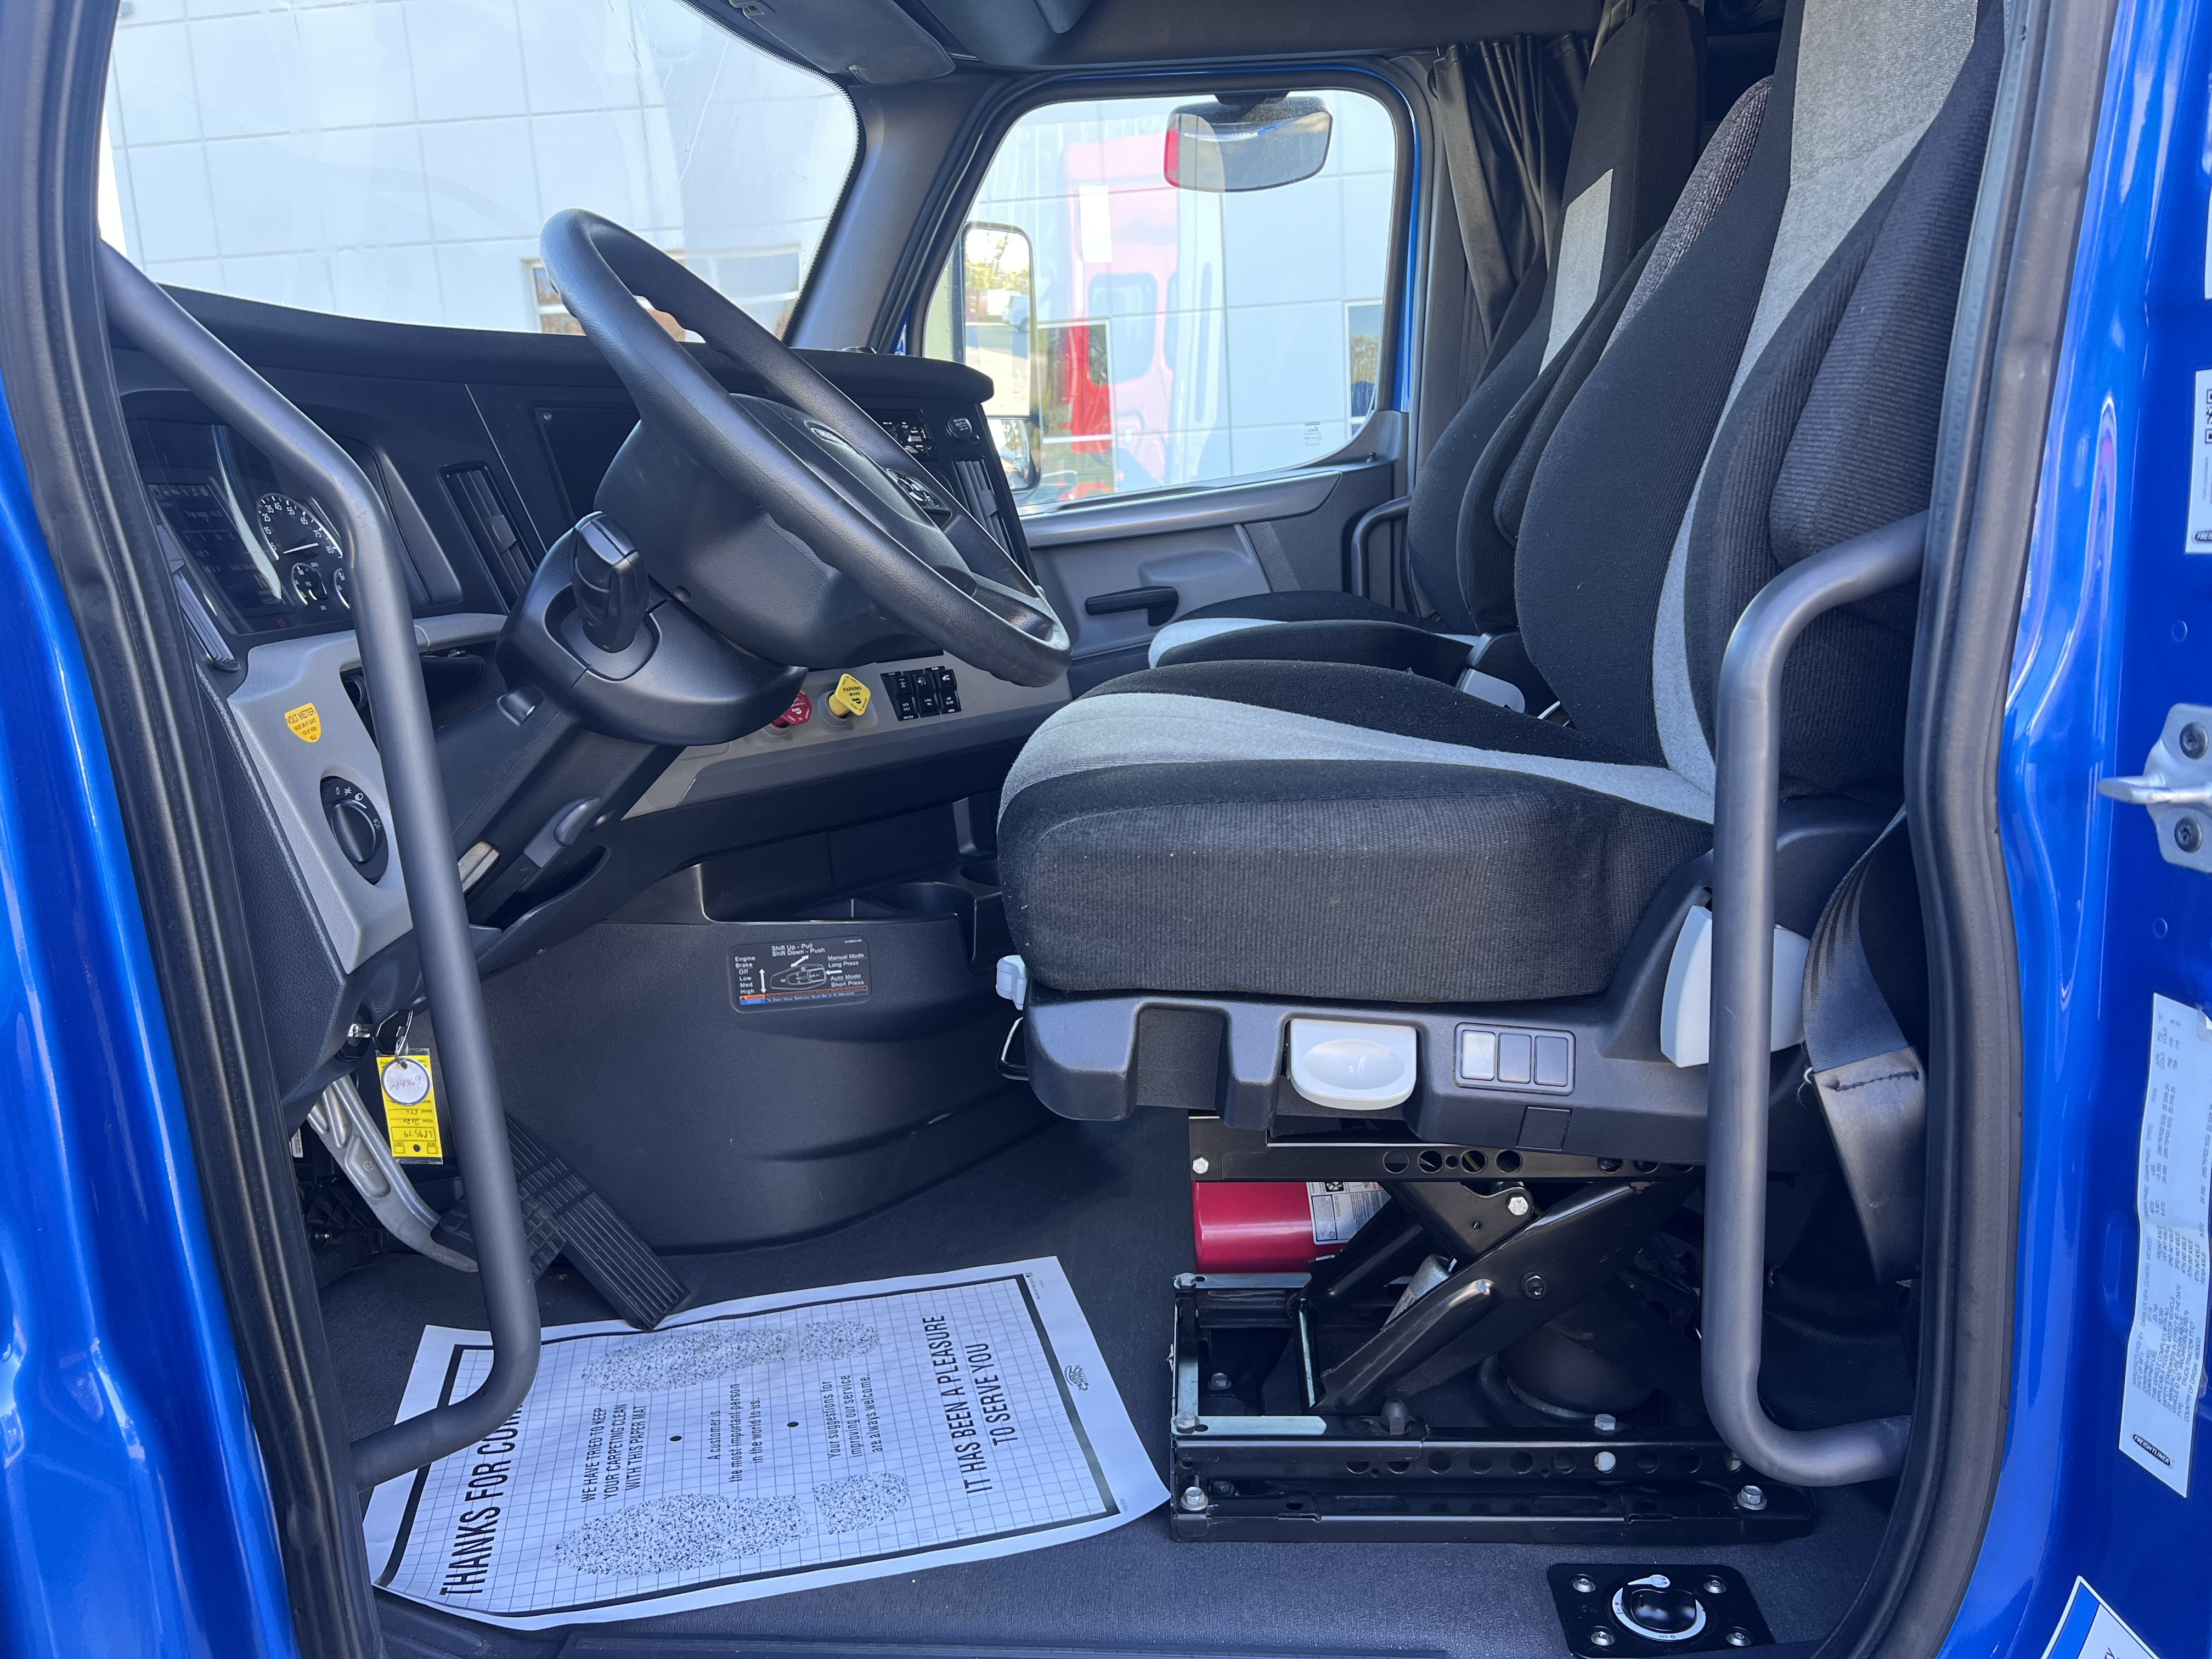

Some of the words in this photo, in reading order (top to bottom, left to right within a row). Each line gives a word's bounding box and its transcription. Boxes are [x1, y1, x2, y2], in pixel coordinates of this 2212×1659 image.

[265, 504, 274, 514] 35
[274, 502, 283, 511] 45
[286, 506, 295, 515] 55
[262, 513, 271, 522] 25
[300, 516, 308, 525] 65
[263, 526, 272, 535] 15
[313, 529, 322, 538] 75
[285, 714, 298, 725] VOLT
[297, 707, 315, 720] METER
[388, 1075, 421, 1091] 204369
[922, 1315, 961, 1384] PLEASURE
[2157, 1332, 2167, 1362] COMPLIES
[2165, 1350, 2176, 1385] STANDARDS
[2174, 1312, 2179, 1321] AT
[965, 1343, 994, 1374] YOU
[2138, 1364, 2143, 1374] OF
[820, 1381, 833, 1393] for
[839, 1375, 854, 1404] service
[860, 1374, 875, 1411] welcome.
[940, 1386, 966, 1396] A
[2157, 1368, 2165, 1404] APPLICABLE
[2188, 1384, 2193, 1393] OF
[730, 1384, 744, 1410] person
[750, 1397, 761, 1409] us.
[974, 1374, 1011, 1423] SERVE
[2167, 1403, 2172, 1411] OF
[591, 1407, 607, 1425] KEEP
[611, 1403, 627, 1426] CLEAN
[632, 1406, 647, 1420] MAT
[822, 1394, 840, 1439] suggestions
[845, 1406, 856, 1418] our
[944, 1401, 977, 1438] BEEN
[590, 1426, 605, 1437] TO
[630, 1421, 646, 1444] PAPER
[708, 1419, 721, 1452] customer
[727, 1411, 744, 1447] important
[748, 1419, 763, 1440] world
[866, 1412, 881, 1439] always
[845, 1419, 864, 1458] improving
[989, 1426, 1018, 1446] TO
[586, 1437, 603, 1461] TRIED
[606, 1427, 624, 1471] CARPETING
[628, 1445, 644, 1466] THIS
[749, 1441, 763, 1454] the
[827, 1441, 842, 1459] Your
[871, 1440, 883, 1453] are
[2134, 1435, 2169, 1464] FREIGHTLINER
[729, 1448, 742, 1468] most
[749, 1455, 763, 1464] in
[954, 1442, 987, 1473] HAS
[464, 1460, 512, 1502] FOR
[583, 1462, 600, 1486] HAVE
[625, 1466, 642, 1491] WITH
[729, 1469, 742, 1482] the
[580, 1487, 597, 1503] WE
[603, 1473, 620, 1500] YOUR
[963, 1479, 993, 1494] IT
[439, 1506, 501, 1595] THANKS
